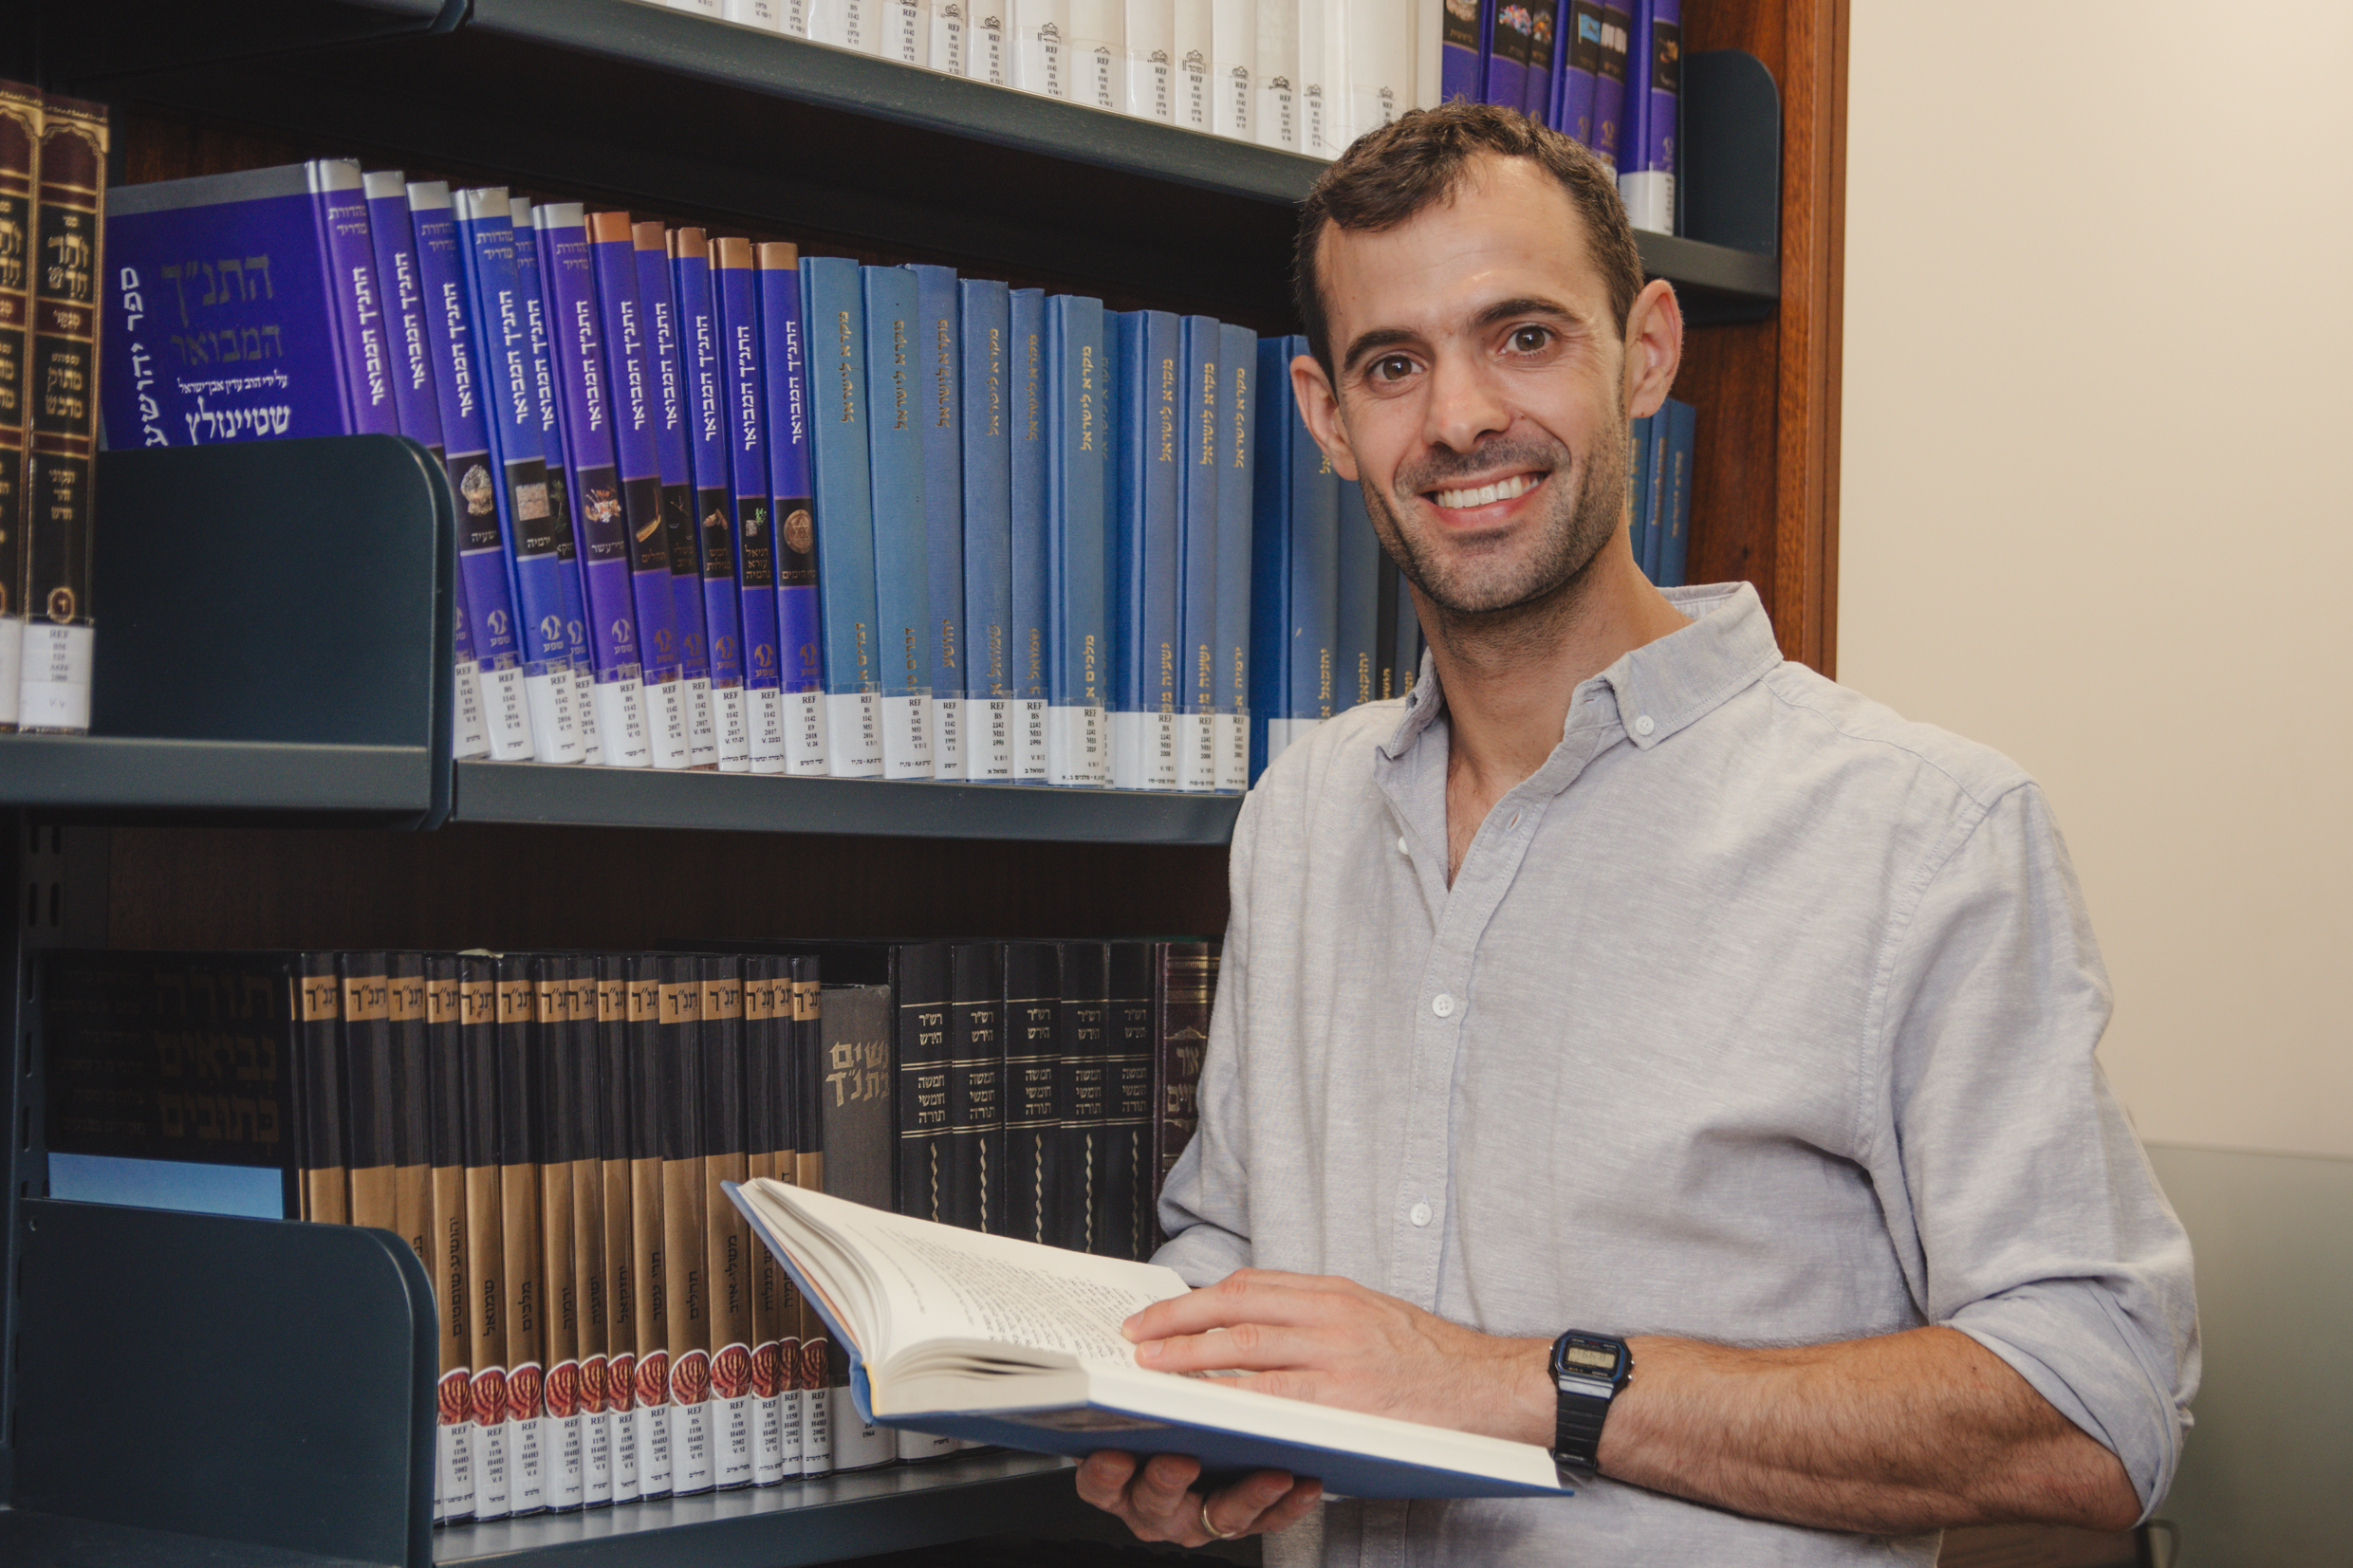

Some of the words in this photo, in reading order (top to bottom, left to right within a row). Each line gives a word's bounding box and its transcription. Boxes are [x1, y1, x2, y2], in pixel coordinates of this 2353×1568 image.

[337, 223, 367, 235] מדריד
[476, 230, 513, 245] מהדורת
[483, 248, 513, 260] מדריד
[120, 267, 143, 331] ספר
[171, 325, 282, 365] המבואר
[403, 314, 425, 389] המבואר
[838, 311, 851, 357] מקרא
[893, 320, 907, 365] מקרא
[937, 320, 951, 365] מקרא
[361, 329, 384, 405] המבואר
[1028, 334, 1039, 378] מקרא
[1083, 346, 1093, 389] מקרא
[47, 367, 82, 391] מתוק
[225, 378, 242, 395] עדין
[245, 378, 261, 389] הרב
[262, 376, 273, 385] ידי
[273, 368, 287, 389] על
[452, 343, 472, 417] המבואר
[507, 351, 528, 424] המבואר
[535, 360, 554, 431] המבואר
[583, 360, 602, 431] המבואר
[627, 360, 645, 430] המבואר
[660, 360, 676, 430] המבואר
[838, 362, 854, 422] לישראל
[935, 367, 950, 427] לישראל
[1162, 359, 1174, 401] מקרא
[1204, 362, 1215, 405] מקרא
[46, 395, 83, 418] מדבש
[185, 396, 290, 446] שטיינזלץ
[700, 372, 716, 441] המבואר
[741, 382, 756, 451] המבואר
[788, 377, 802, 444] המבואר
[892, 371, 907, 430] לישראל
[1025, 381, 1038, 440] לישראל
[1080, 394, 1092, 451] לישראל
[1159, 406, 1172, 462] לישראל
[1200, 410, 1214, 465] לישראל
[527, 537, 550, 548] ירמיה
[641, 549, 665, 563] תהלים
[677, 558, 694, 567] איוב
[709, 547, 728, 557] חמש
[745, 544, 769, 557] דניאל
[746, 570, 770, 579] נחמיה
[748, 560, 768, 568] עזרא
[782, 570, 806, 580] הימים
[50, 630, 68, 639] REF
[490, 636, 510, 647] שפע
[543, 641, 564, 653] שפע
[856, 622, 867, 666] דברים
[905, 628, 916, 670] דברים
[942, 619, 954, 668] יהושע
[1026, 628, 1040, 679] שמואל
[498, 673, 514, 683] REF
[755, 669, 774, 677] שפע
[1083, 635, 1095, 682] מלכים
[1161, 643, 1172, 686] ישעיה
[1199, 644, 1210, 688] ישעיה
[1318, 648, 1330, 699] יחזקאל
[1357, 653, 1370, 703] יחזקאל
[723, 692, 738, 700] REF
[1085, 687, 1095, 697] א
[919, 1031, 942, 1045] הירש
[972, 1029, 993, 1042] הירש
[1028, 1026, 1049, 1039] הירש
[829, 1041, 889, 1070] נשים
[1026, 1068, 1051, 1081] חמשה
[918, 1075, 945, 1088] חמשה
[970, 1072, 995, 1085] חמשה
[970, 1089, 995, 1103] חומשי
[1026, 1086, 1051, 1098] חומשי
[919, 1092, 945, 1107] חומשי
[919, 1109, 945, 1123] תורה
[970, 1106, 995, 1119] תורה
[1026, 1102, 1051, 1115] תורה
[652, 1251, 660, 1278] תרי
[483, 1280, 495, 1337] שמואל
[518, 1282, 531, 1332] מלכים
[563, 1288, 571, 1330] ירמיה
[590, 1277, 601, 1324] ישעיה
[618, 1266, 630, 1323] יחזקאל
[653, 1285, 661, 1320] עשר
[686, 1271, 699, 1320] תהלים
[452, 1426, 467, 1435] REF
[453, 1456, 469, 1465] H4H3
